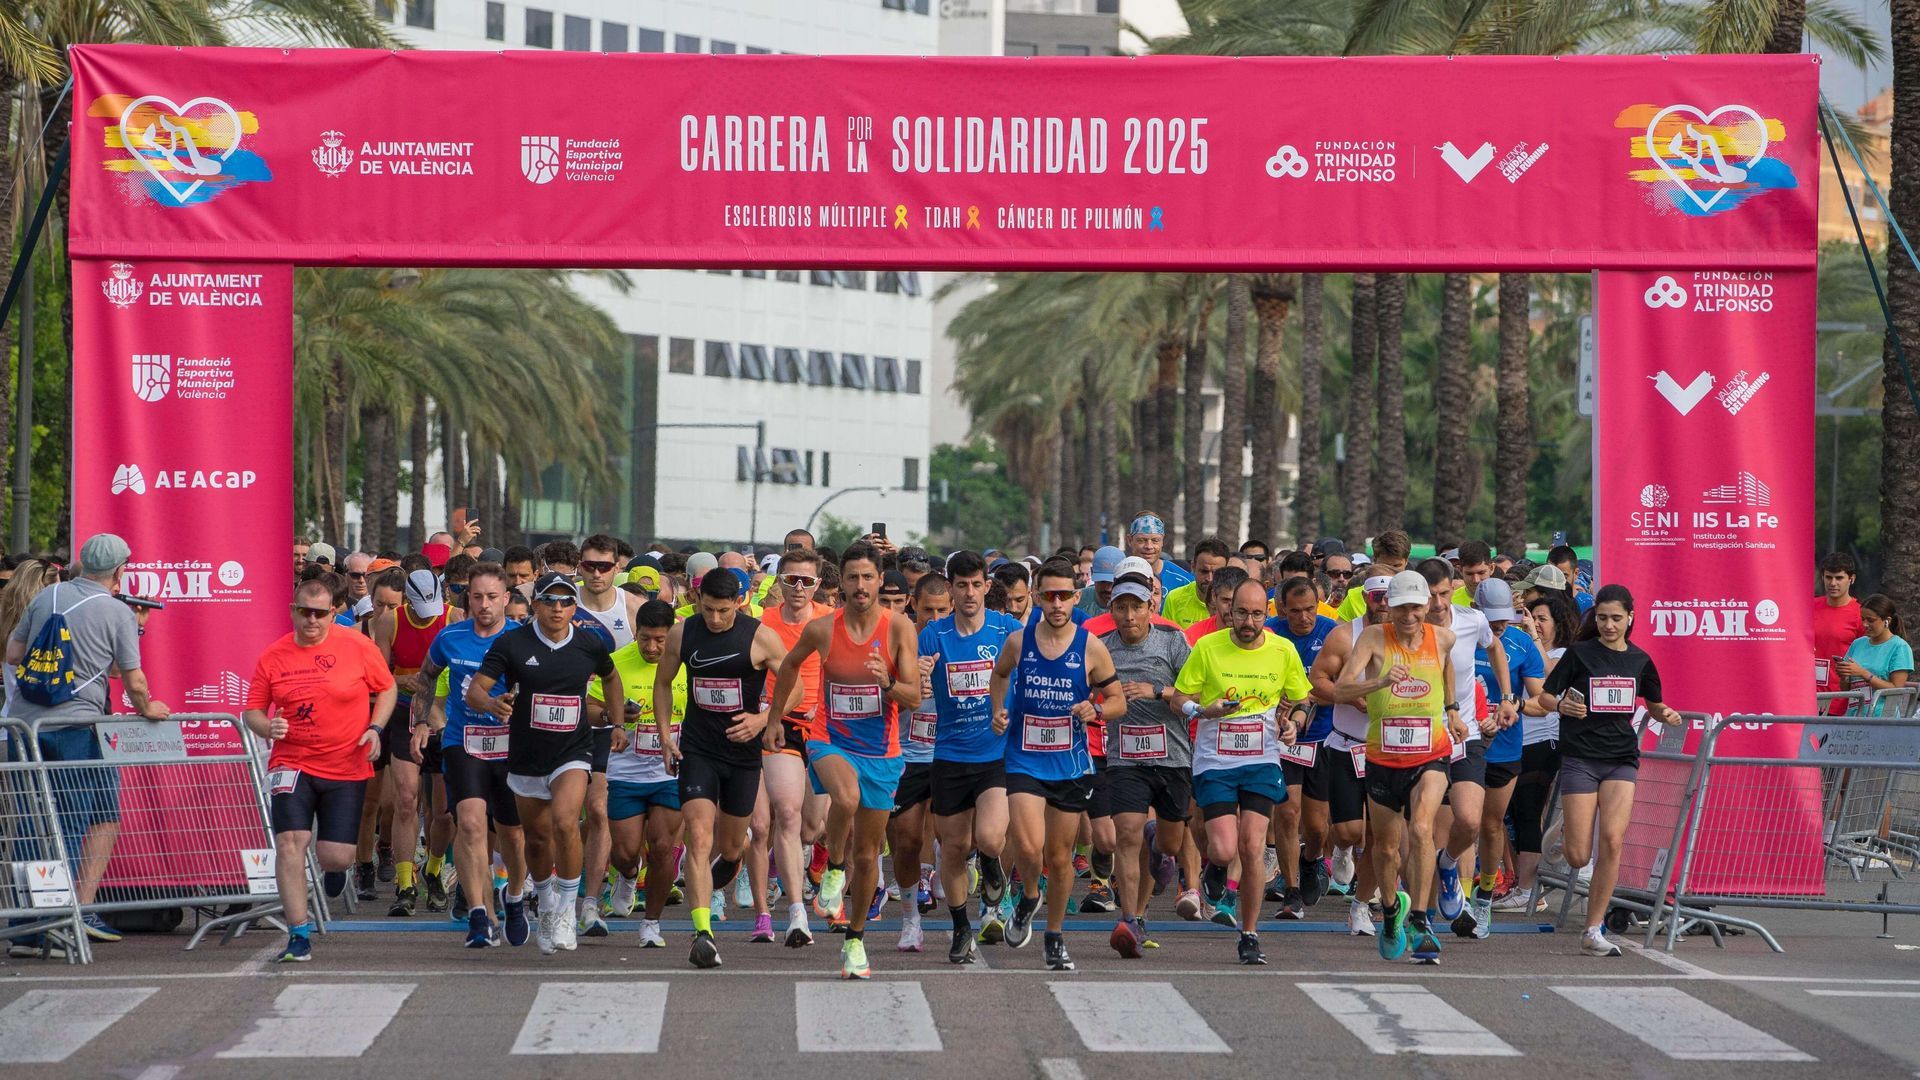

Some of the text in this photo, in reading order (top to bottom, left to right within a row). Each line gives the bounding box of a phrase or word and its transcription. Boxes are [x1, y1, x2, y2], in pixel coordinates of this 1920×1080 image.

[360, 142, 474, 157] AJUNTAMENT
[566, 139, 620, 149] Fundació
[681, 115, 1209, 175] CARRERA POR LA SOLIDARIDAD 2025
[1315, 140, 1395, 151] FUNDACIÓN
[566, 150, 622, 161] Esportiva
[1315, 154, 1396, 167] TRINIDAD
[1495, 141, 1528, 170] VALENCIA
[360, 157, 474, 176] DE VALÈNCIA
[566, 161, 623, 172] Municipal
[1502, 151, 1528, 177] CIUDAD
[1508, 142, 1550, 184] DEL RUNNING
[566, 171, 615, 182] València
[1315, 169, 1396, 182] ALFONSO
[724, 202, 1142, 230] ESCLEROSIS MÚLTIPLE TDAH CÁNCER DE PULMÓN
[150, 274, 263, 287] AJUNTAMENT
[1694, 272, 1773, 281] FUNDACIÓN
[150, 289, 263, 306] DE VALÈNCIA
[1694, 284, 1773, 297] TRINIDAD
[1694, 300, 1773, 313] ALFONSO
[177, 357, 231, 367] Fundació
[177, 368, 233, 379] Esportiva
[177, 378, 235, 389] Municipal
[1715, 370, 1748, 402] VALENCIA
[177, 388, 226, 399] València
[1722, 381, 1749, 409] CIUDAD
[1728, 372, 1770, 416] DEL RUNNING
[1630, 512, 1679, 528] SENI
[1694, 512, 1779, 528] IIS La Fe
[1693, 541, 1776, 551] Investigación Sanitaria
[124, 560, 213, 570] sociación
[228, 570, 239, 578] 16
[120, 571, 213, 598] TDAH
[1652, 598, 1749, 608] Asociación
[1765, 608, 1775, 617] 16
[1651, 610, 1749, 636] TDAH
[965, 673, 979, 688] 341
[1026, 675, 1072, 689] POBLATS
[1394, 681, 1428, 694] Serrano
[711, 690, 726, 704] 635
[1024, 688, 1074, 701] MARÍTIMS
[1608, 689, 1622, 703] 670
[849, 697, 864, 711] 319
[549, 707, 565, 722] 540
[182, 732, 220, 740] stituto de
[1041, 728, 1056, 743] 503
[1234, 733, 1249, 748] 399
[1399, 728, 1415, 744] 387
[482, 737, 496, 752] 657
[1135, 736, 1151, 751] 249
